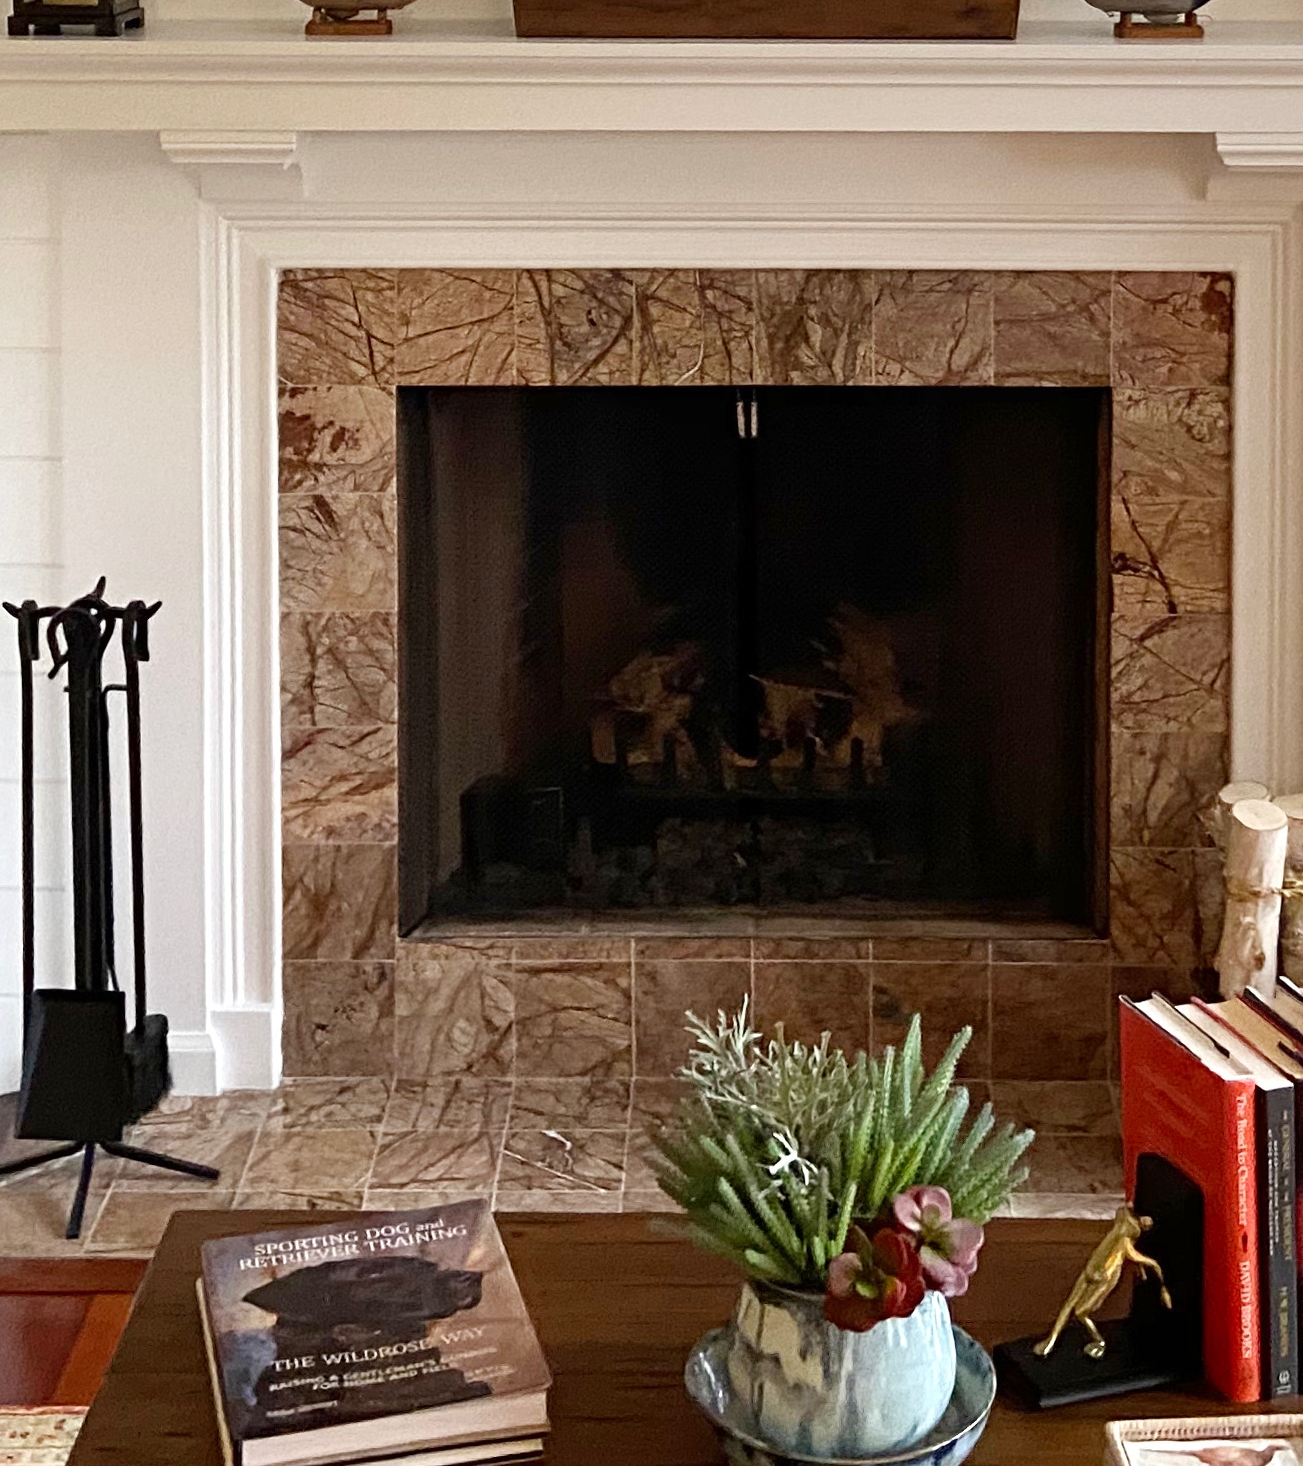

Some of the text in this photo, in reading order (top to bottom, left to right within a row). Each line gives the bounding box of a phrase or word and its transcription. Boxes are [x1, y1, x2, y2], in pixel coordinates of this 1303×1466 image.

[1238, 1166, 1248, 1227] Character
[239, 1224, 467, 1270] RETRIEVER TRAINING
[254, 1218, 444, 1256] SPORTING DOG and
[1239, 1261, 1252, 1358] DAVID BROOKS
[270, 1326, 486, 1372] THE WILDROSE WAY
